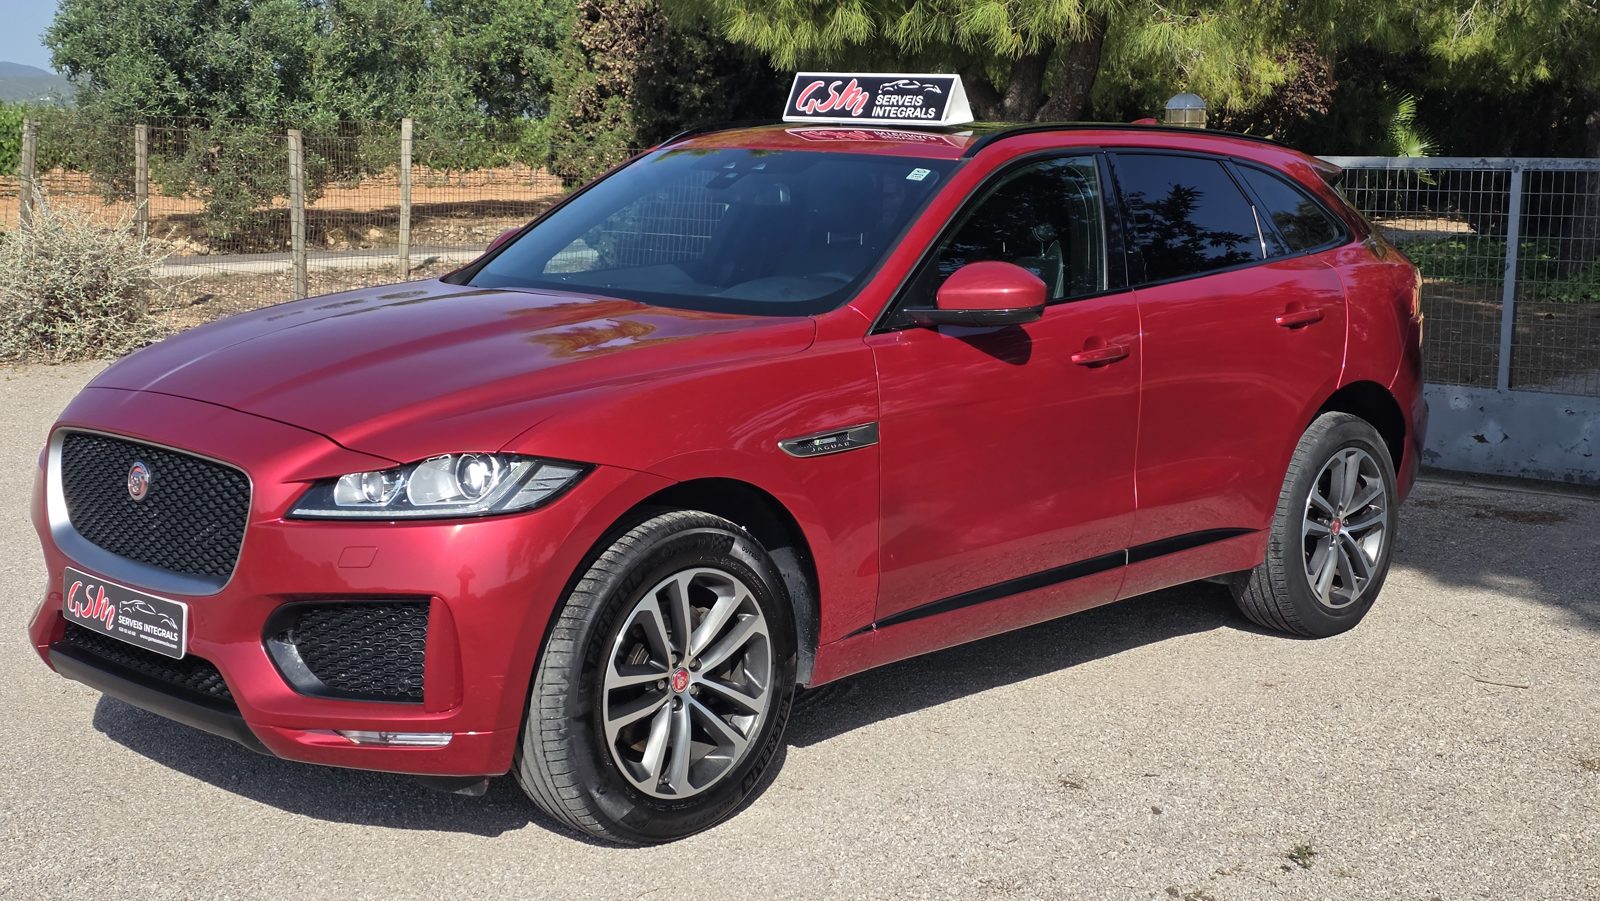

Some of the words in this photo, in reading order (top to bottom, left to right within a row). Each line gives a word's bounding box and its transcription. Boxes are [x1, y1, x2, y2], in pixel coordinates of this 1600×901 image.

[875, 95, 923, 106] SERVEIS
[871, 105, 935, 119] INTEGRALS
[811, 441, 849, 452] JAGUAR
[118, 616, 143, 631] SERVEIS
[143, 623, 178, 642] INTEGRALS
